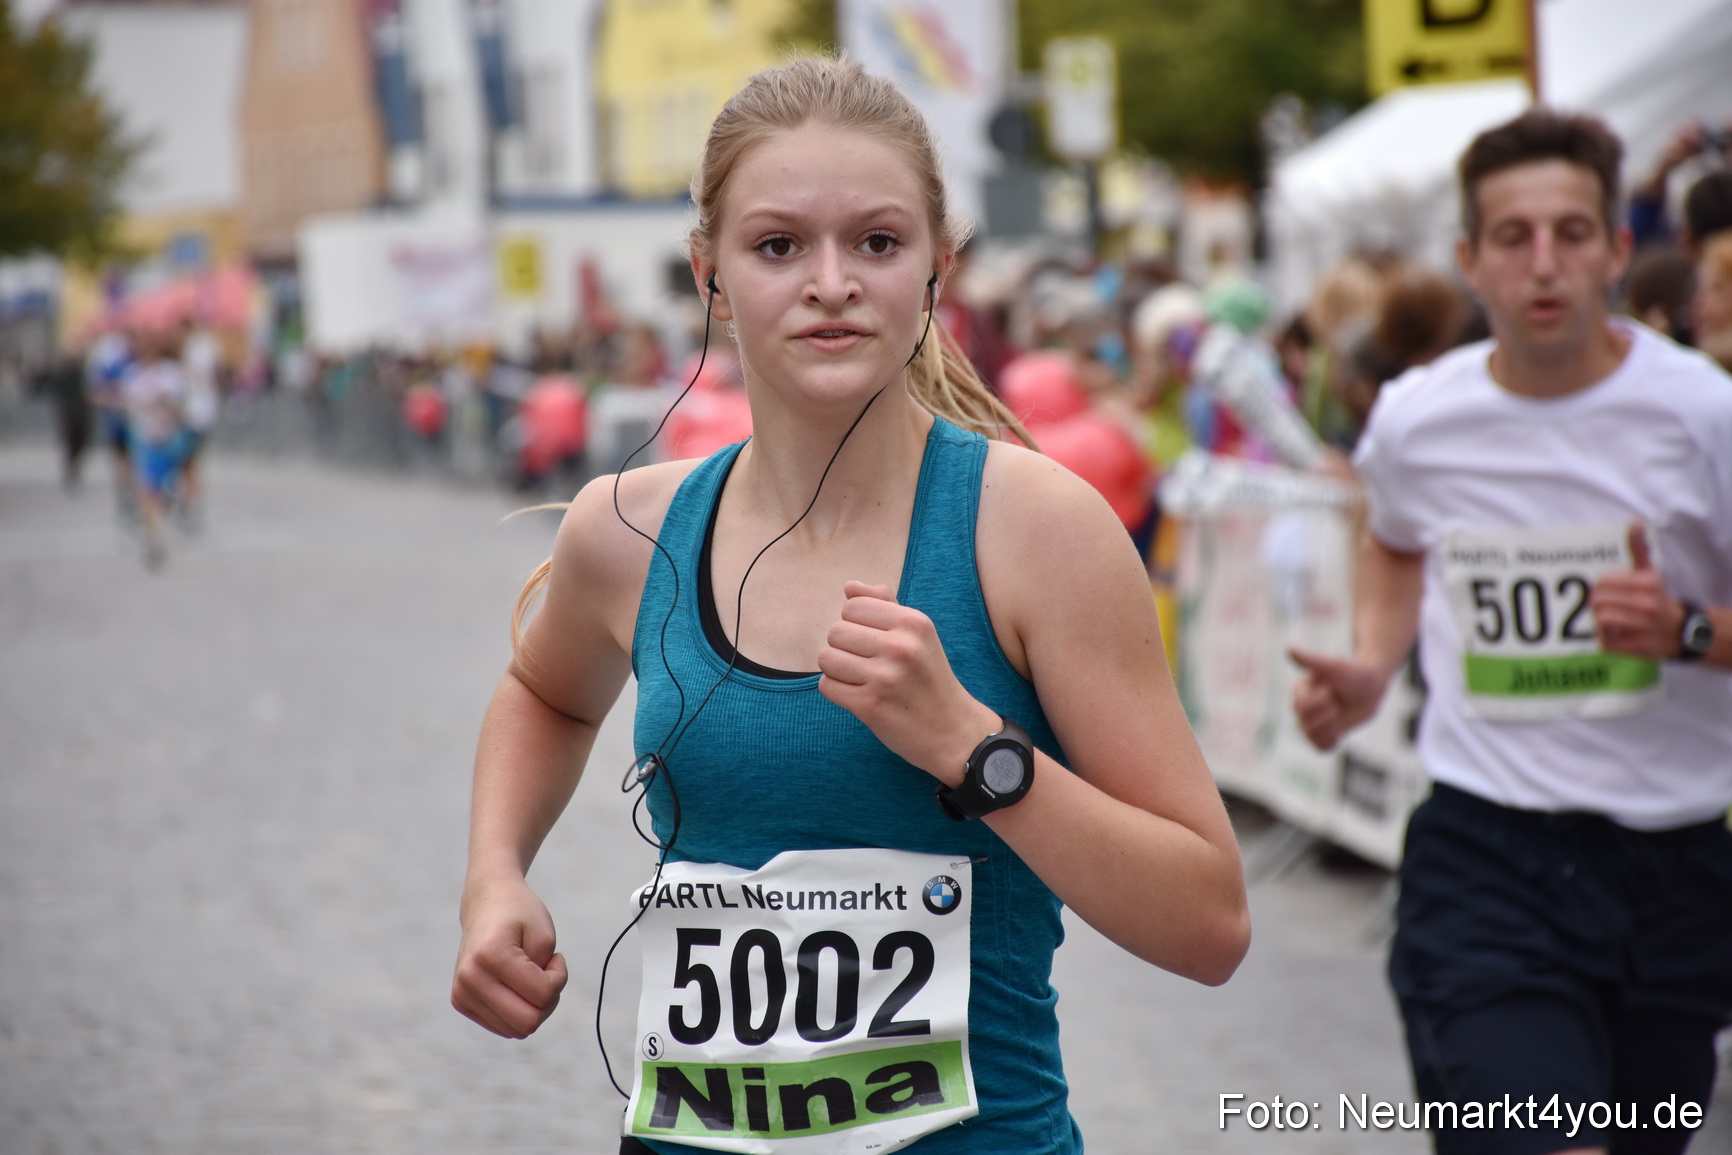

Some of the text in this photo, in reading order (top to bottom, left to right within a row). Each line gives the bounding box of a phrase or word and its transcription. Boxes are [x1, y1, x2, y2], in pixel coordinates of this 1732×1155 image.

[1471, 575, 1597, 643] 502
[639, 883, 739, 909] PARTL
[740, 882, 907, 910] Neumarkt
[668, 928, 935, 1046] 5002
[649, 1036, 657, 1057] S
[649, 1060, 945, 1132] Nina
